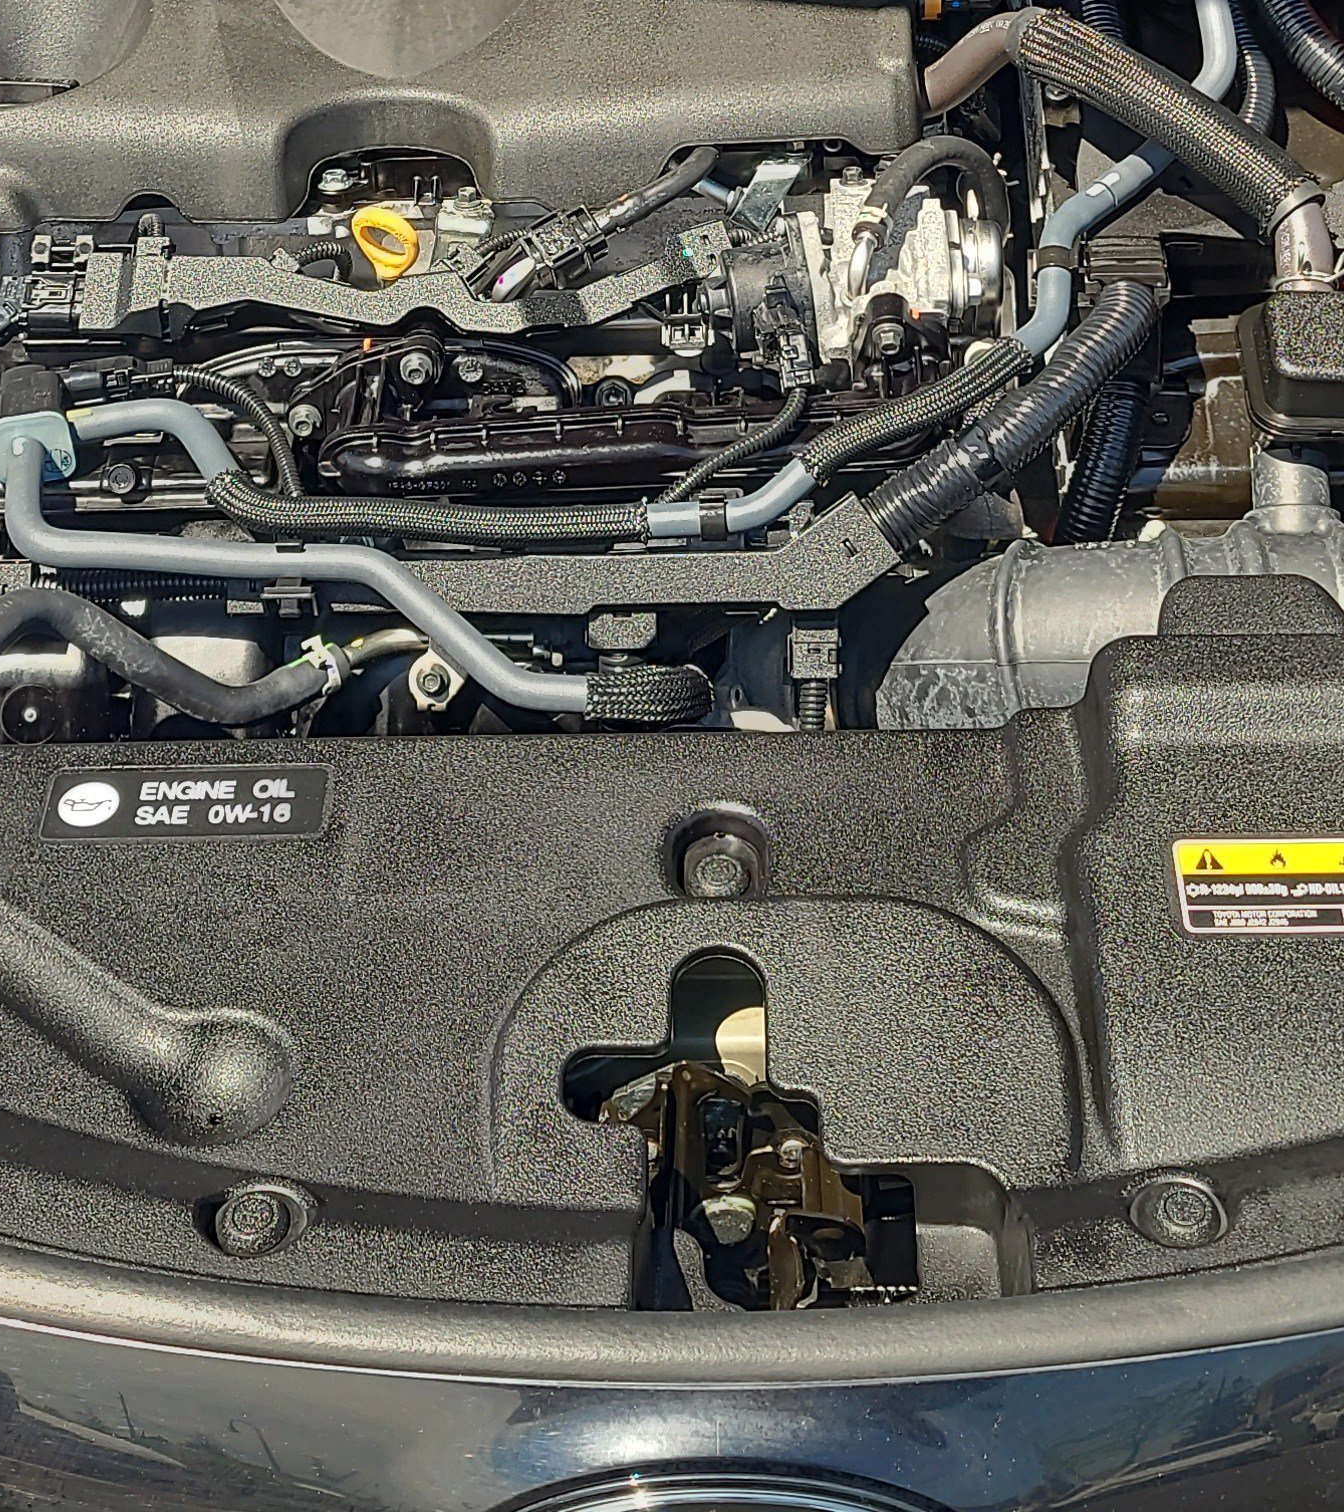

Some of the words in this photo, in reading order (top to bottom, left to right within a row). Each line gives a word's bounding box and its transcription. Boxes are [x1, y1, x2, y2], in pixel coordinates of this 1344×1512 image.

[138, 779, 237, 801] ENGINE
[252, 777, 296, 799] OIL
[133, 804, 189, 825] SAE
[207, 802, 293, 825] 0W-16
